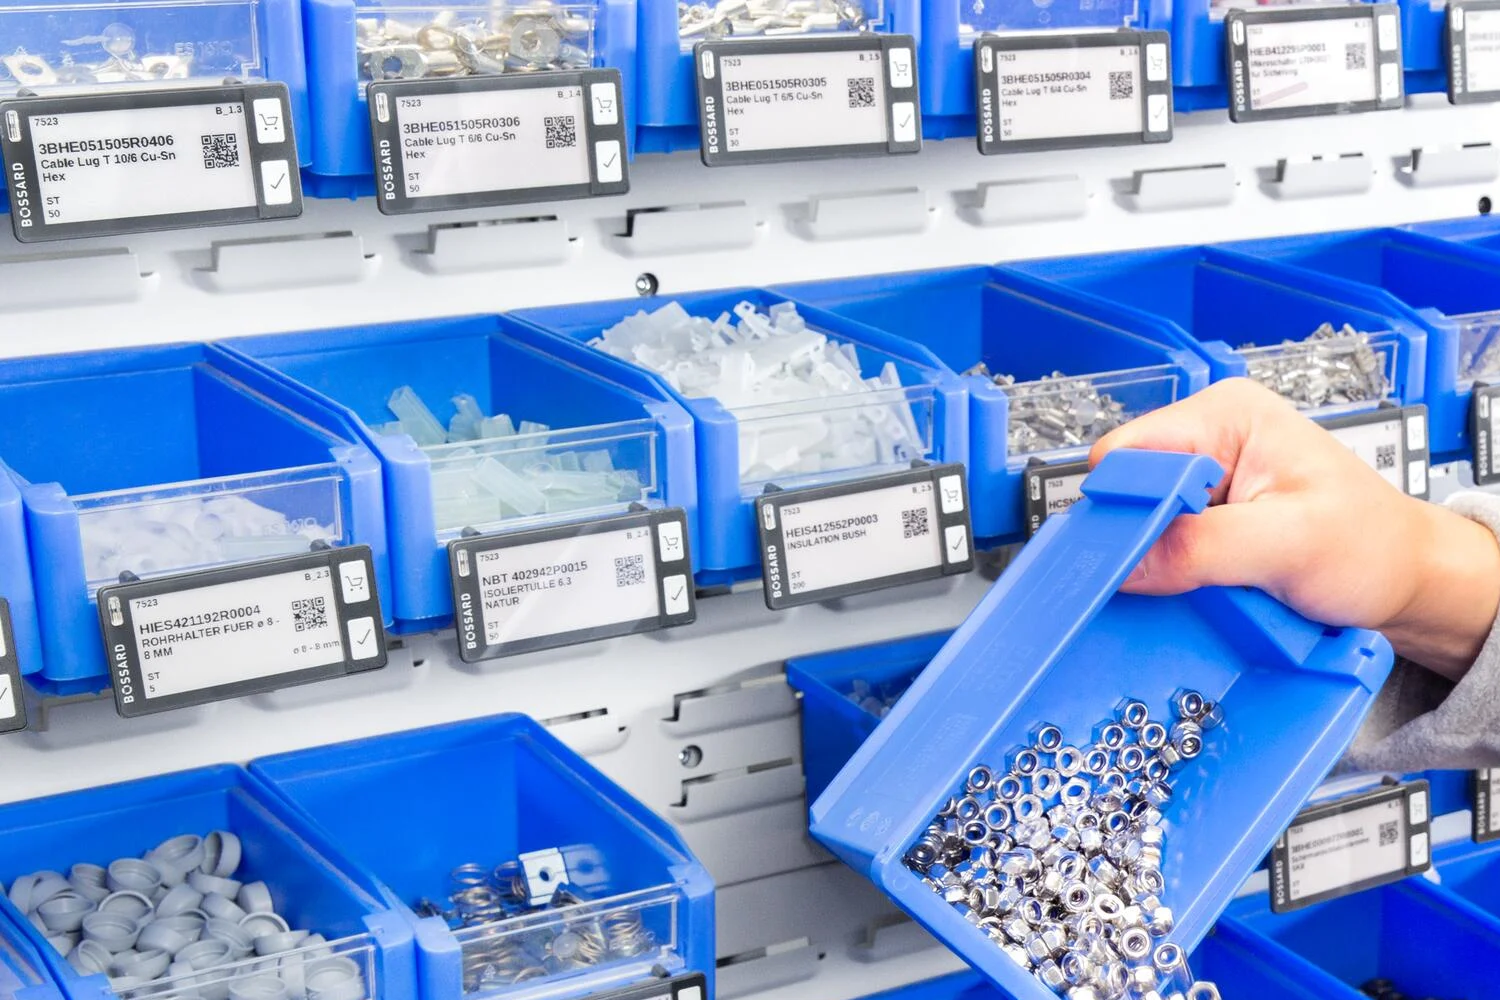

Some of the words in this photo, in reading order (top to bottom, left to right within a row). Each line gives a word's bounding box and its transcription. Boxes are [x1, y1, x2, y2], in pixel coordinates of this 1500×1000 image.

[724, 59, 741, 67] 7523
[726, 77, 827, 92] 3BHE051505R0305
[1001, 88, 1024, 97] Cable
[1026, 87, 1041, 96] Lug
[1064, 85, 1087, 93] Cu-Sn
[1234, 60, 1245, 111] BOSSARD
[558, 90, 581, 99] B_1.4
[727, 95, 751, 104] Cable
[754, 94, 770, 103] Lug
[773, 93, 778, 101] T
[781, 93, 794, 101] 6/5
[796, 92, 823, 100] Cu-Sn
[216, 106, 242, 116] B_1.3
[727, 107, 744, 115] Hex
[983, 89, 993, 142] BOSSARD
[34, 118, 58, 126] 7523
[404, 117, 520, 134] 3BHE051505R0306
[705, 96, 718, 153] BOSSARD
[39, 135, 174, 154] 3BHE051505R0406
[405, 137, 434, 147] Cable
[436, 135, 455, 146] Lug
[459, 135, 465, 143] T
[468, 134, 482, 143] 6/6
[485, 132, 515, 142] Cu-Sn
[41, 158, 75, 169] Cable
[78, 156, 100, 168] Lug
[104, 156, 110, 164] T
[114, 154, 137, 164] 10/6
[141, 151, 176, 162] Cu-Sn
[406, 150, 425, 160] Hex
[43, 172, 66, 182] Hex
[380, 139, 395, 200] BOSSARD
[12, 162, 32, 228] BOSSARD
[49, 210, 60, 218] 50
[786, 514, 878, 538] HEIS412552P0003
[787, 534, 840, 550] INSULATION
[842, 529, 866, 541] BUSH
[480, 553, 499, 562] 7523
[304, 570, 330, 581] B_2.3
[483, 573, 508, 586] NBT
[512, 561, 587, 581] 402942P0015
[768, 545, 782, 598] BOSSARD
[484, 581, 556, 598] ISOLIERTULLE
[136, 599, 158, 609] 7523
[486, 597, 520, 609] NATUR
[140, 604, 260, 634] HIES421192R0004
[462, 593, 476, 649] BOSSARD
[488, 622, 498, 630] ST
[142, 626, 220, 648] ROHRHALTER
[223, 622, 254, 634] FUER
[267, 618, 273, 626] 8
[323, 640, 340, 648] mm
[144, 652, 150, 660] 8
[153, 648, 173, 658] MM
[115, 644, 134, 704] BOSSARD
[148, 672, 160, 680] ST
[1276, 861, 1284, 904] BOSSARD
